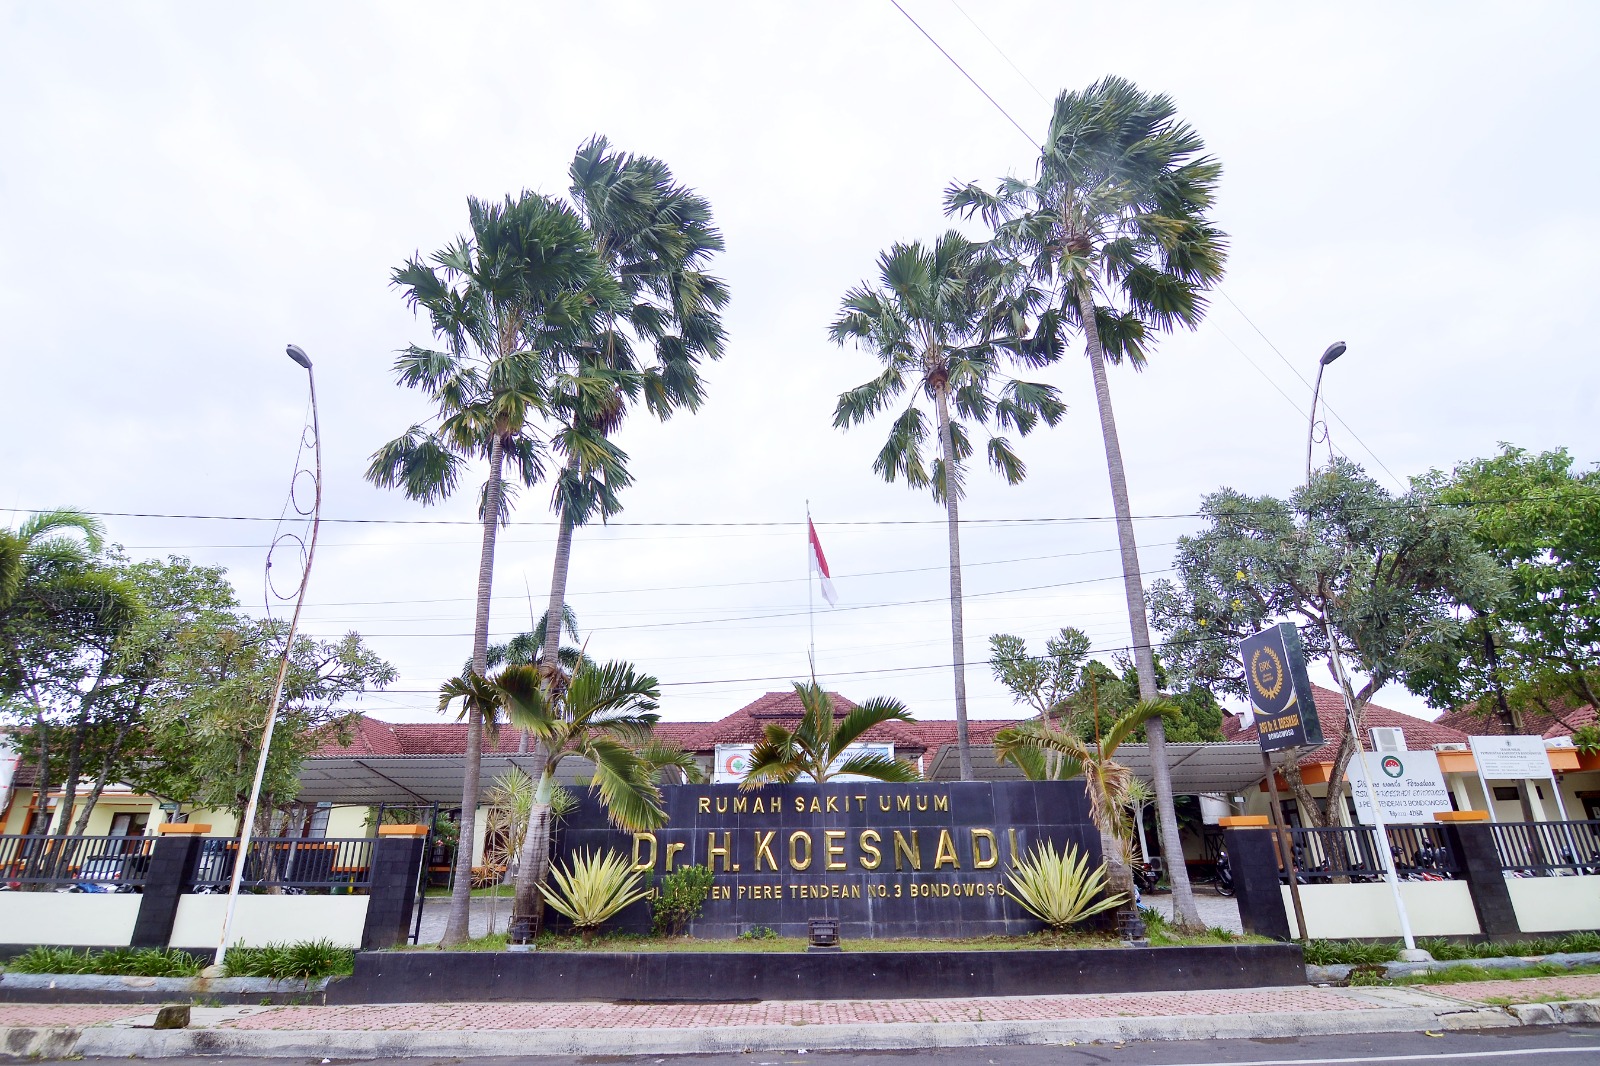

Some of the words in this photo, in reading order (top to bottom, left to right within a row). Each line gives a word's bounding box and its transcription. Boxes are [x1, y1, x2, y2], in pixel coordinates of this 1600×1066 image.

[699, 797, 782, 814] RUMAH
[795, 795, 867, 813] SAKIT
[879, 794, 949, 812] UMUM
[754, 828, 1021, 872] KOESNADI
[738, 885, 782, 900] PIERE
[790, 884, 861, 899] TENDEAN
[910, 883, 1006, 898] BONDOWOSO
